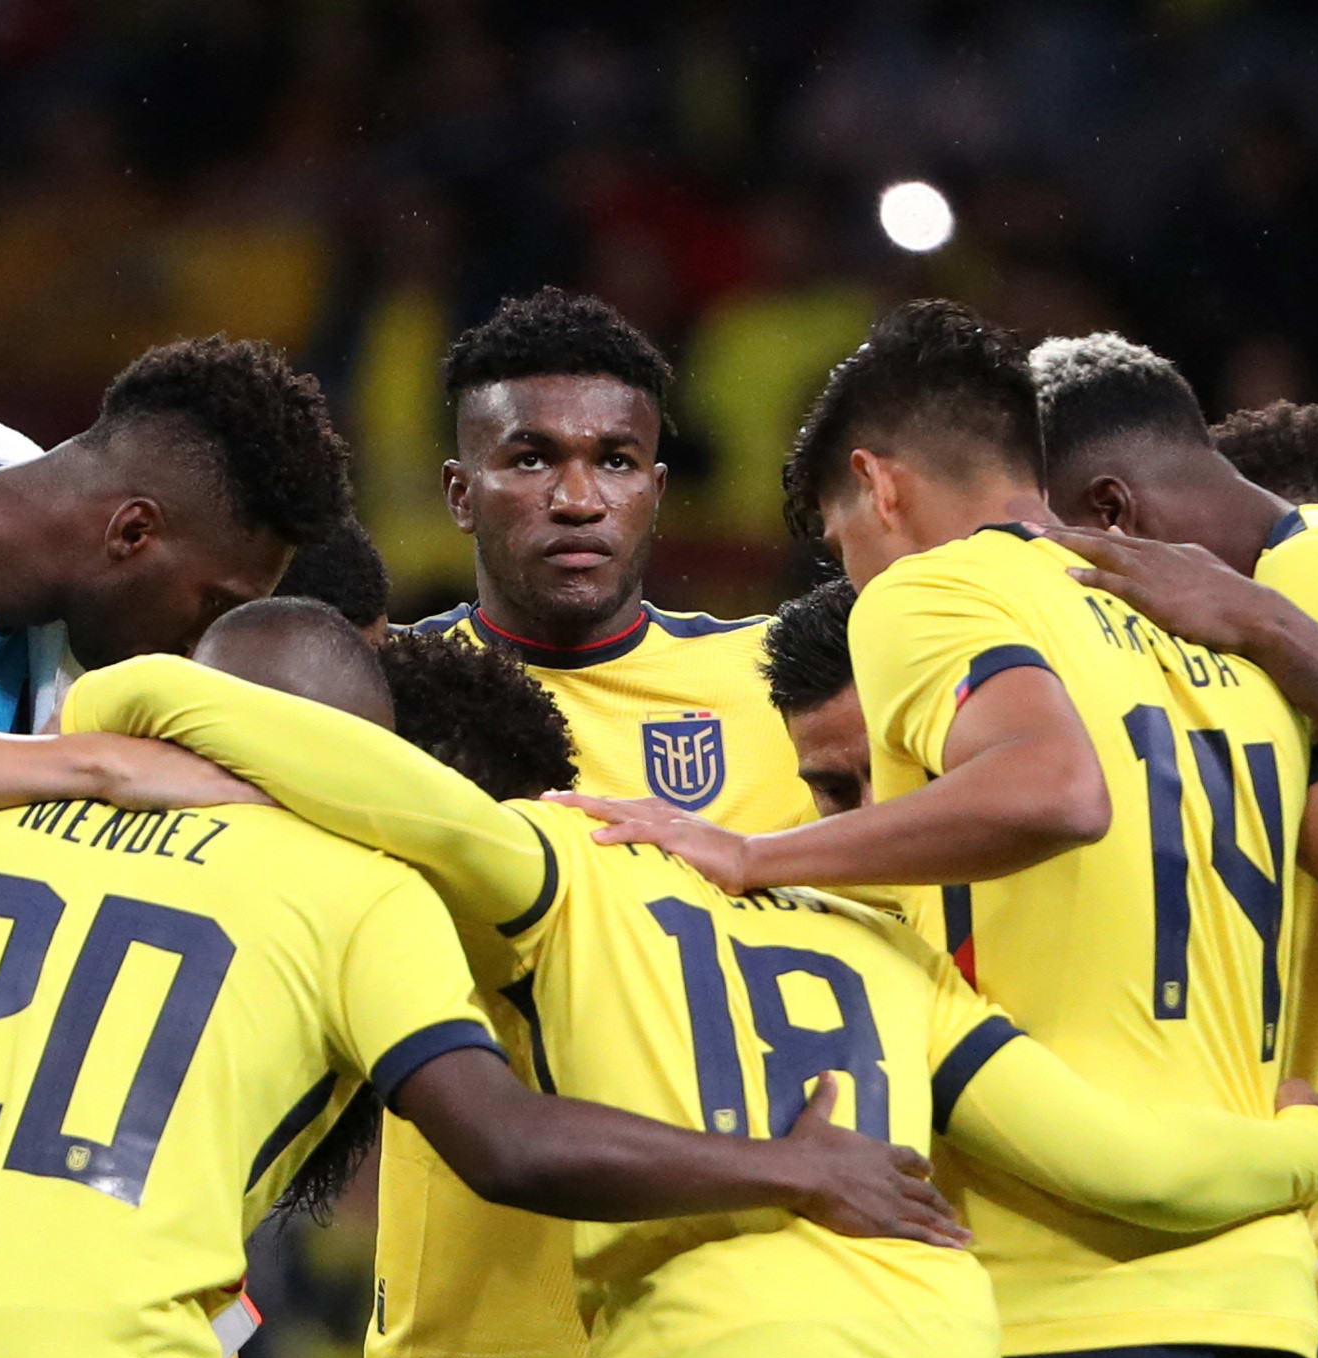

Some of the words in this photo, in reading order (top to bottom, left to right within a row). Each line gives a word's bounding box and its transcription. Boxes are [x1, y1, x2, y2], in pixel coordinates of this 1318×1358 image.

[17, 799, 230, 866] MENDEZ
[1122, 703, 1284, 1063] 14
[644, 895, 891, 1144] 18
